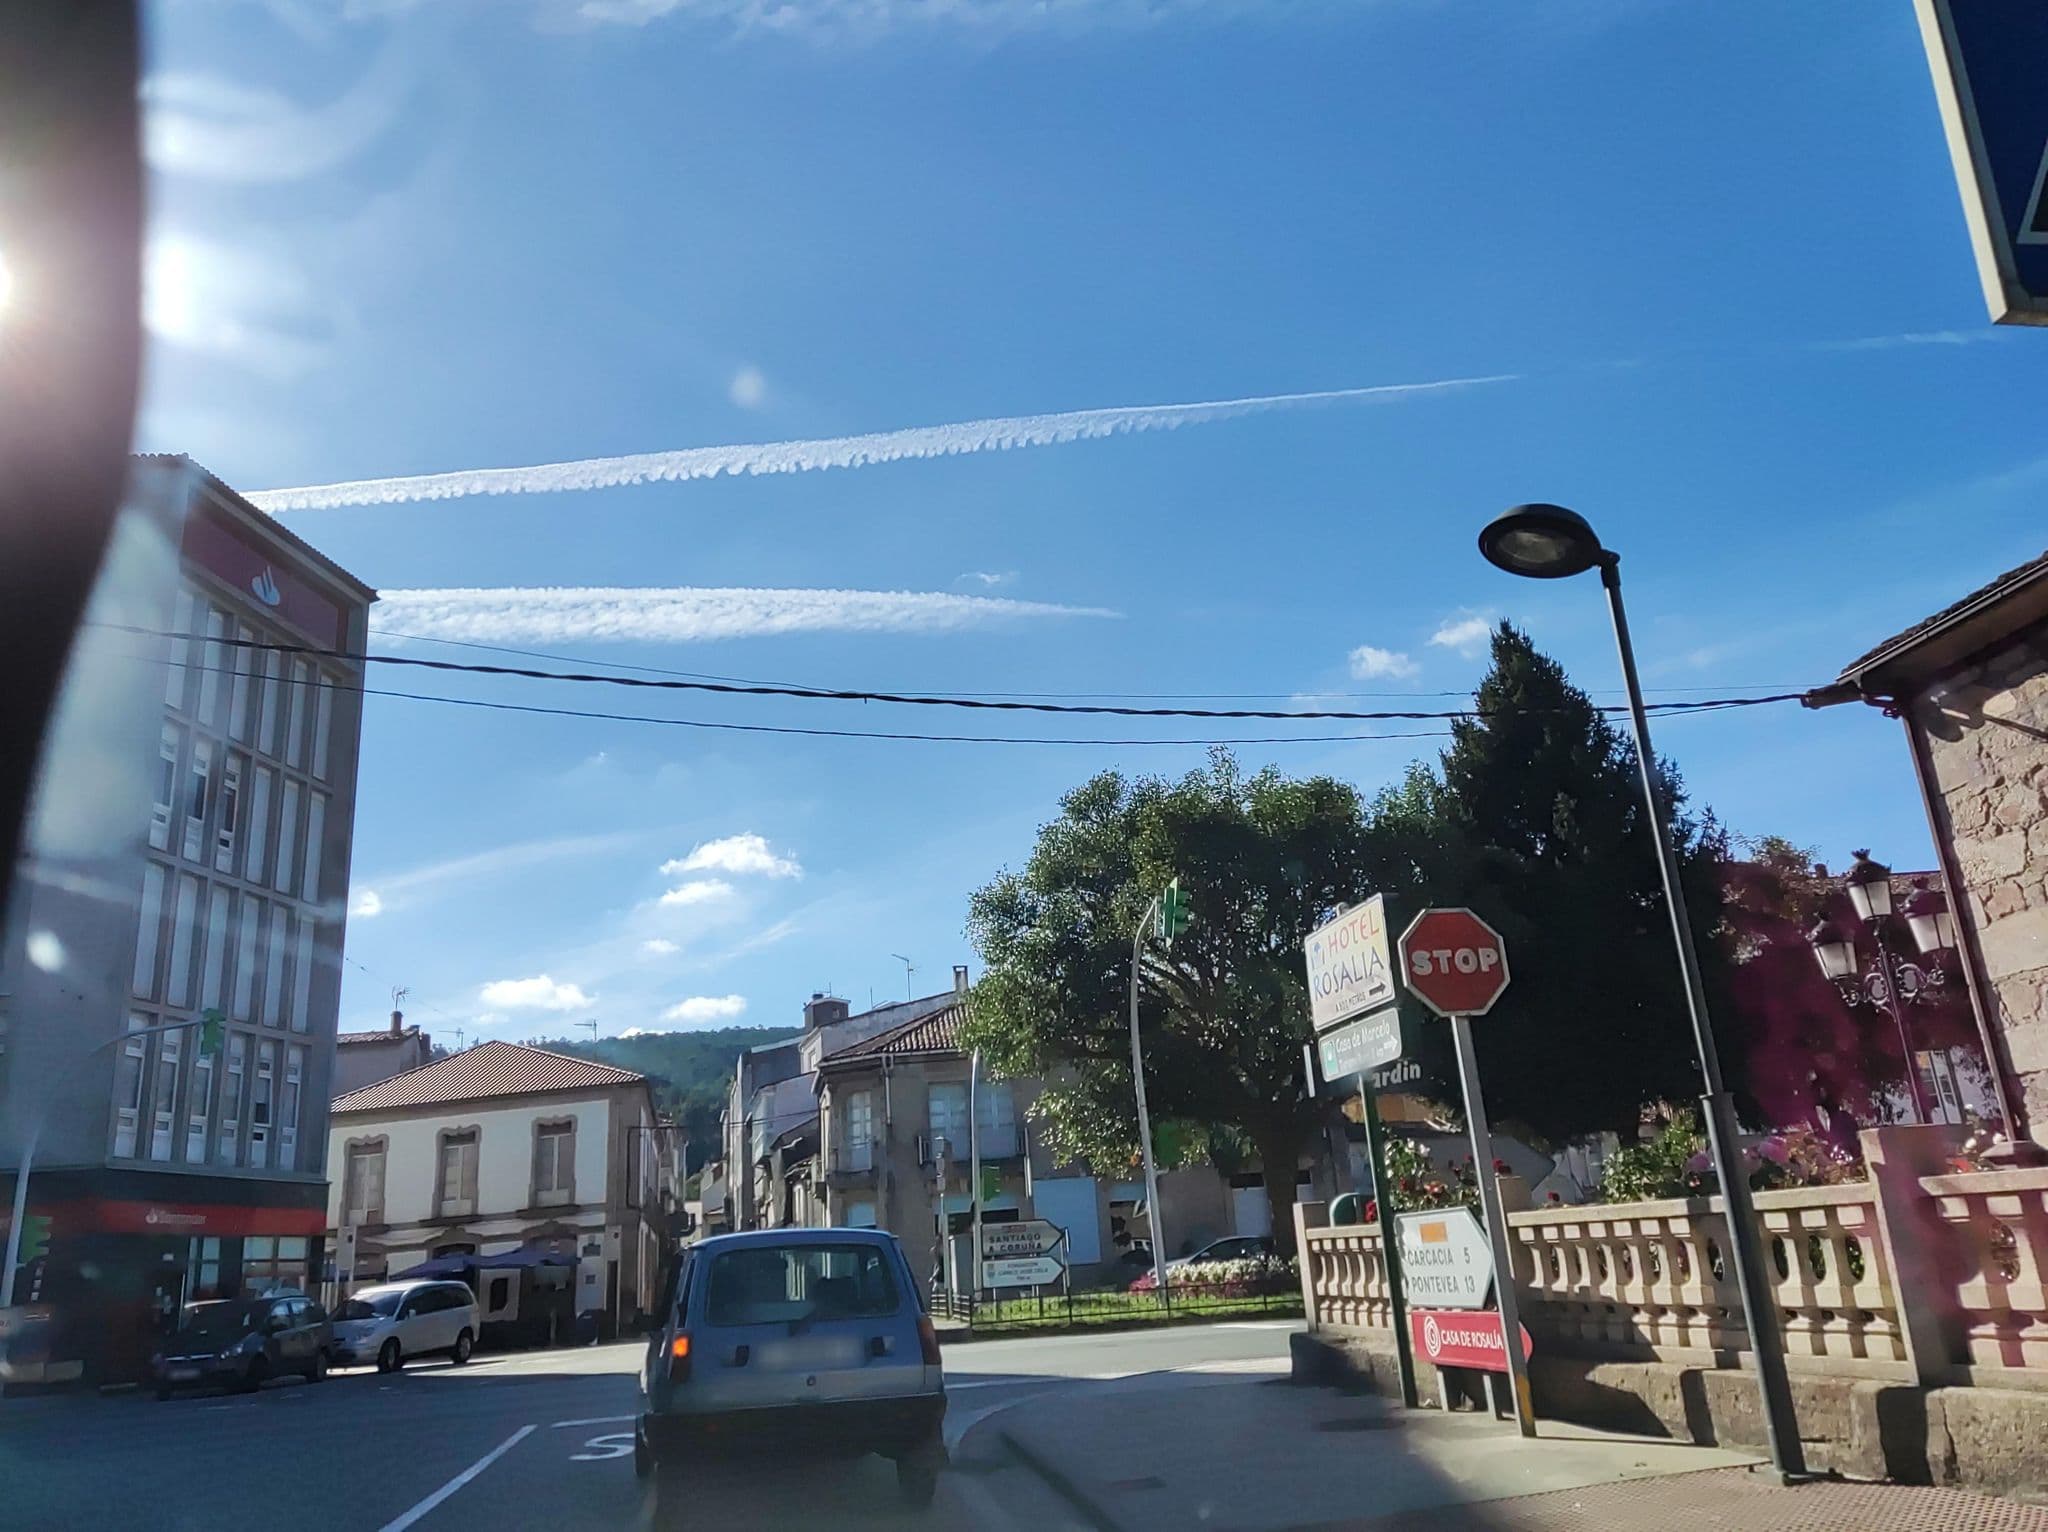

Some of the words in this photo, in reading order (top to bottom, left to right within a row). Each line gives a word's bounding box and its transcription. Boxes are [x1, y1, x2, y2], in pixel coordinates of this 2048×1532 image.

[1328, 910, 1379, 957] HOTEL
[1313, 947, 1384, 1001] ROSALIA
[1411, 948, 1499, 976] STOP
[1336, 1037, 1352, 1053] Casa
[1352, 1033, 1361, 1047] de
[1361, 1019, 1390, 1043] Marcelo
[1371, 1061, 1421, 1088] ardin
[988, 1233, 1041, 1244] SANTIAGO
[1407, 1248, 1454, 1266] CARCACIA
[1464, 1248, 1471, 1264] 5
[1411, 1276, 1459, 1294] PONTEVEA
[1464, 1277, 1476, 1294] 13
[1441, 1330, 1460, 1346] CASA
[1460, 1331, 1472, 1347] DE
[1472, 1329, 1504, 1350] ROSALÍA
